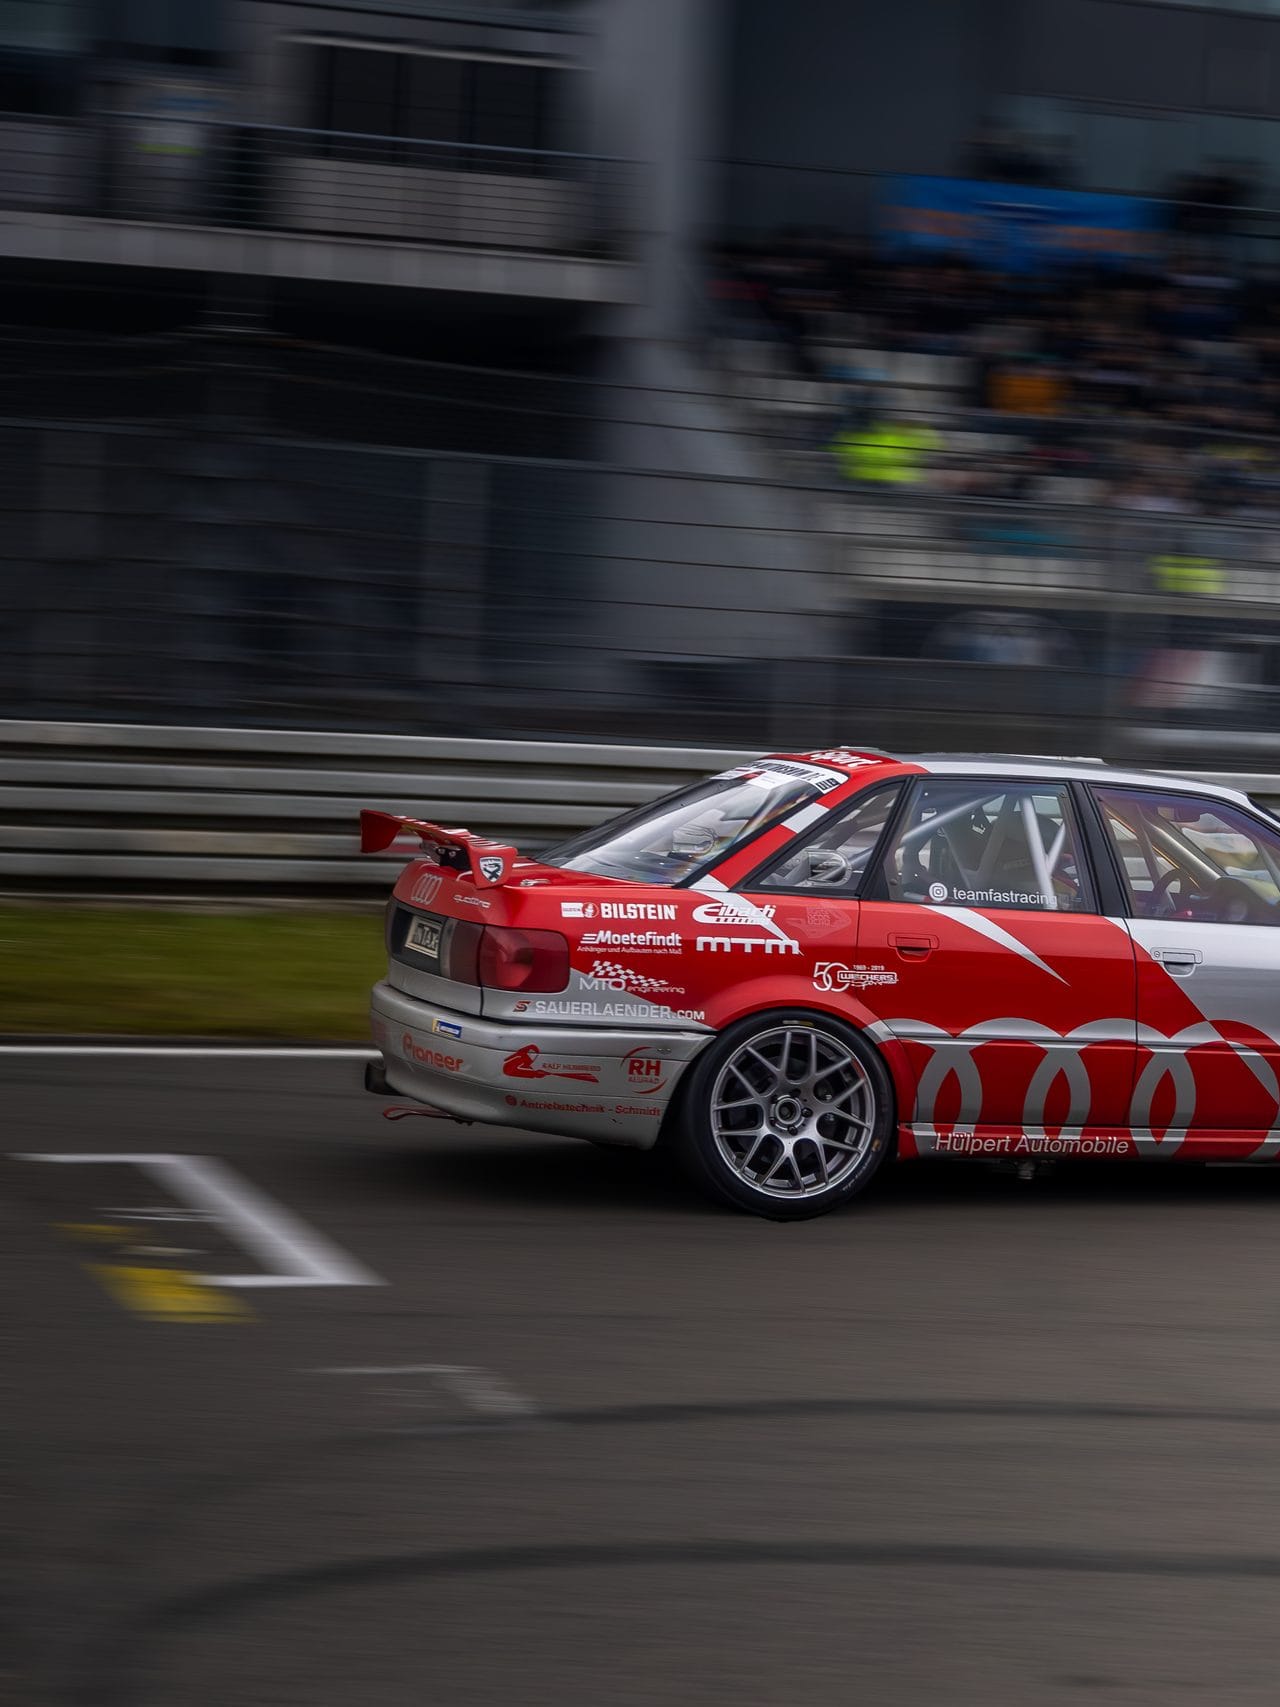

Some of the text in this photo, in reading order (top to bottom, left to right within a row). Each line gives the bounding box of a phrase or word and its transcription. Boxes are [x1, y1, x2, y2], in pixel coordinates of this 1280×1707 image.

[600, 903, 675, 920] BILSTEIN
[594, 930, 682, 947] Moetefindt
[403, 1031, 464, 1073] Pioneer
[627, 1058, 661, 1077] RH
[520, 1099, 604, 1114] Antriebstechnik
[615, 1104, 661, 1117] Schmidt
[934, 1133, 1129, 1155] Hülpert Automobile
